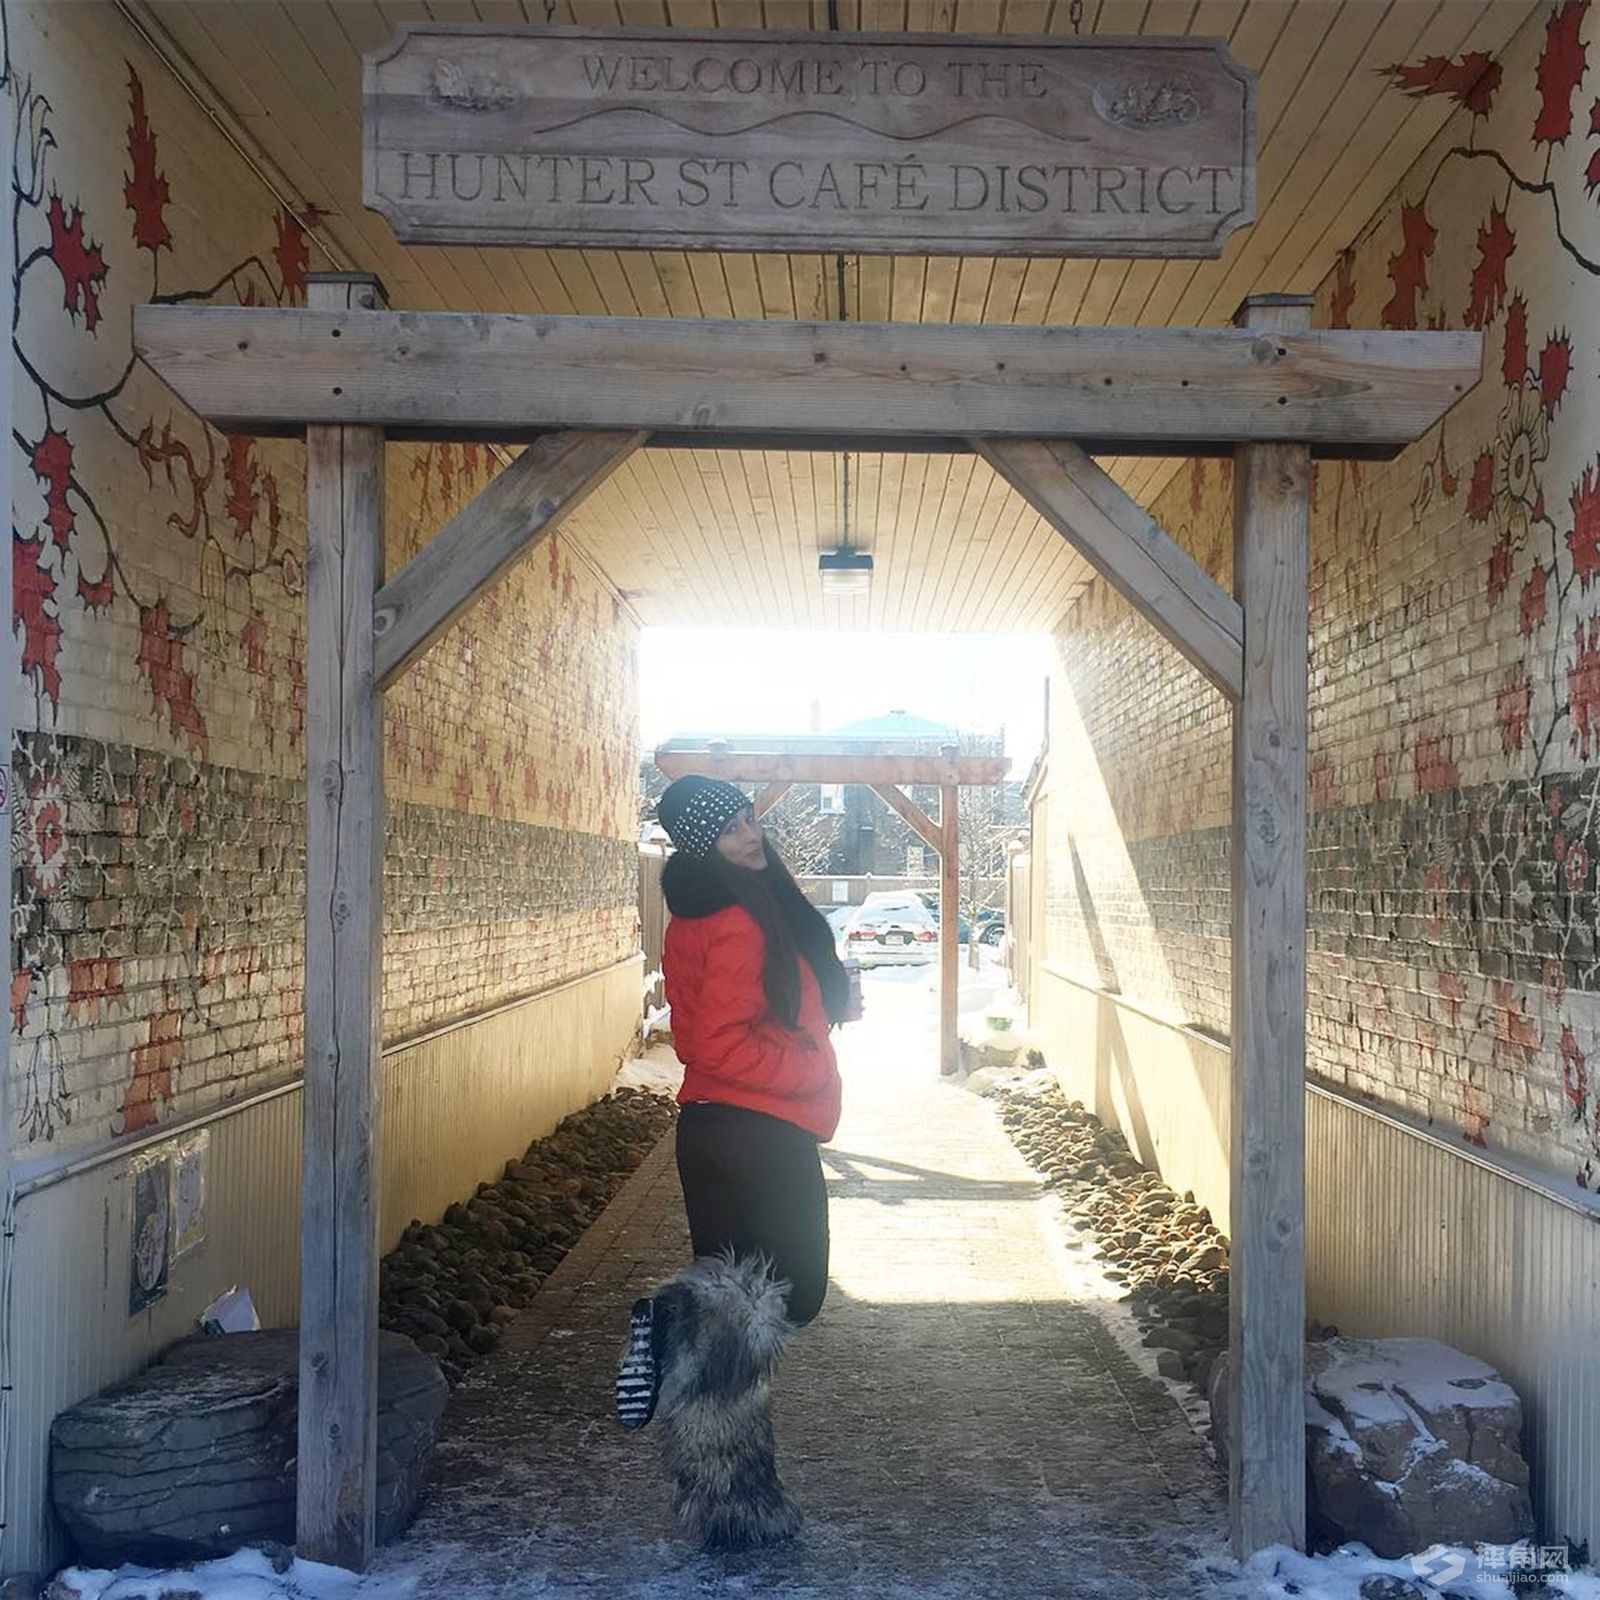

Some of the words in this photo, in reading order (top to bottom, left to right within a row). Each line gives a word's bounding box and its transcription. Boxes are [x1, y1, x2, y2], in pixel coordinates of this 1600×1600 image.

[582, 55, 843, 97] WELCOME
[860, 61, 927, 97] TO
[947, 63, 1049, 99] THE
[401, 152, 660, 206] HUNTER
[678, 159, 750, 208] ST
[769, 154, 930, 212] CAFÉ
[949, 164, 1236, 216] DISTRICT
